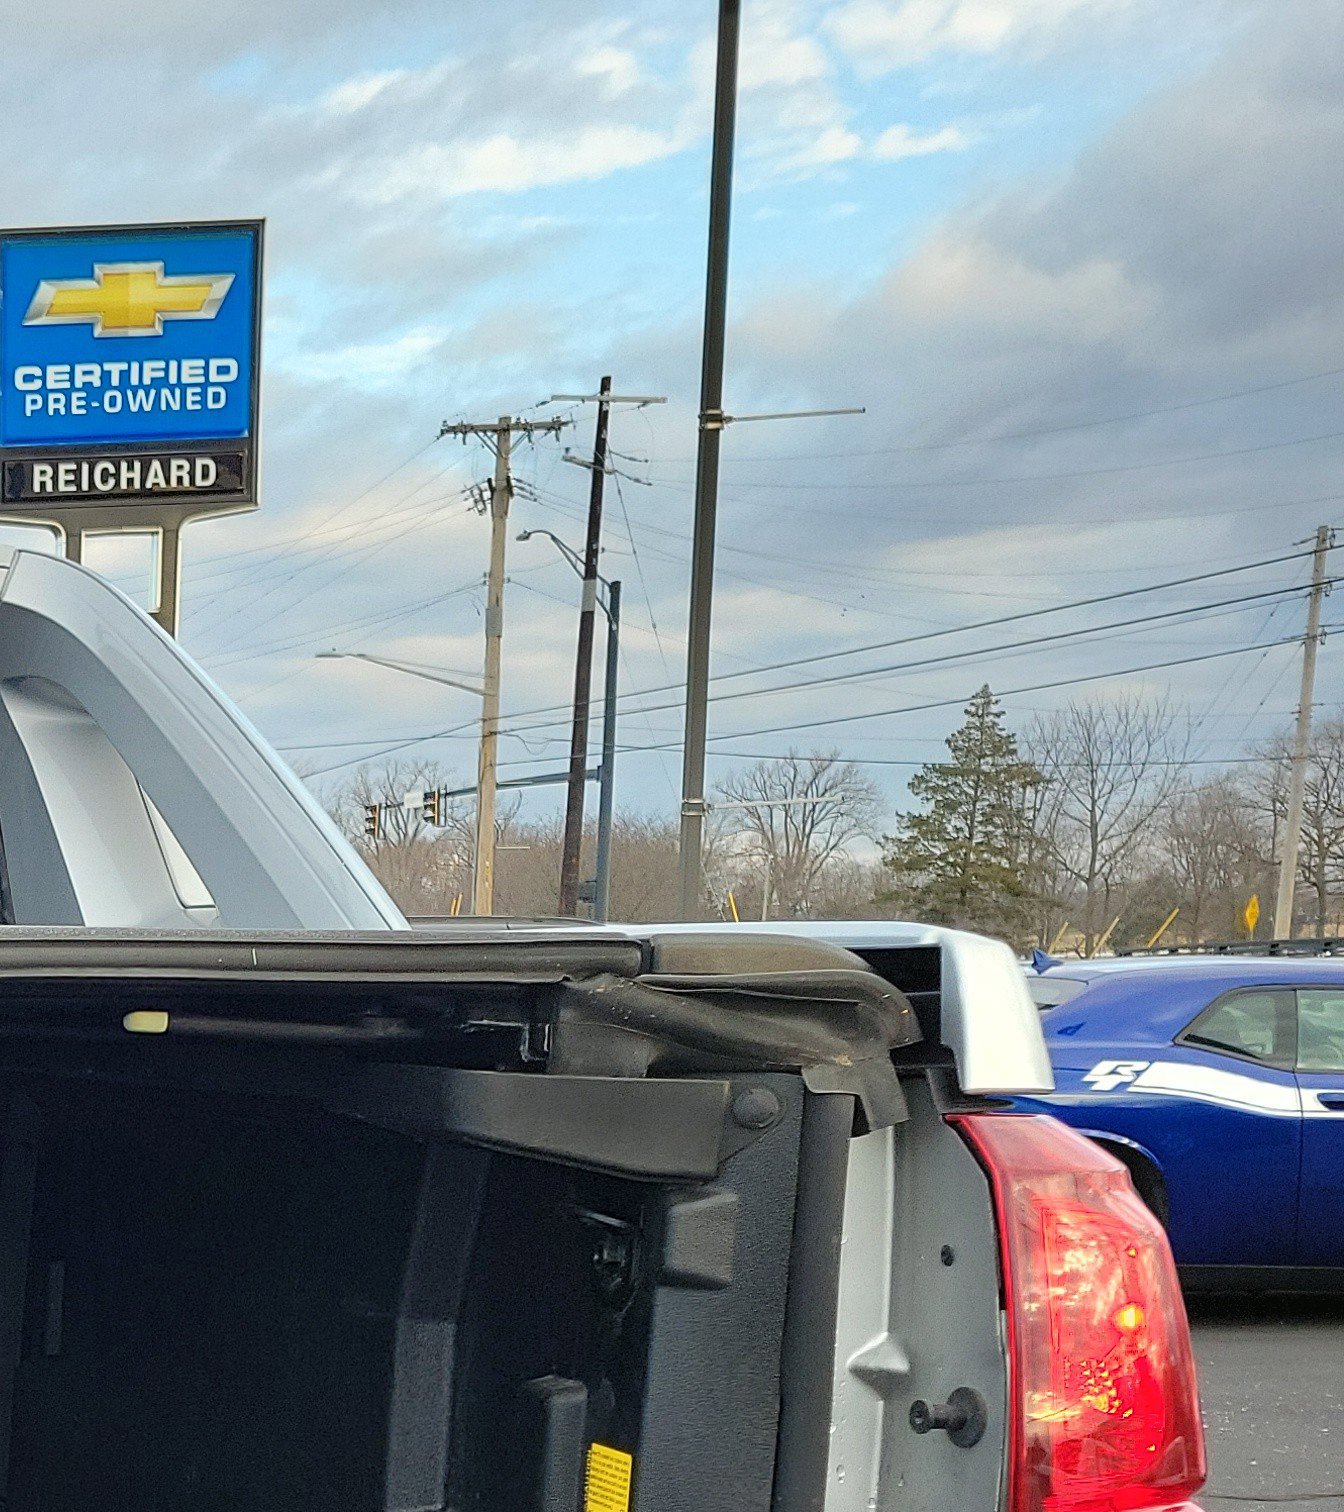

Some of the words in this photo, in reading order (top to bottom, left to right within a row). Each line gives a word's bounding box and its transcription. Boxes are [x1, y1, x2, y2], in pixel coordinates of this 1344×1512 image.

[14, 357, 239, 392] CERTIFIED
[24, 386, 227, 417] PRE-OWNED
[32, 456, 217, 494] REICHARD
